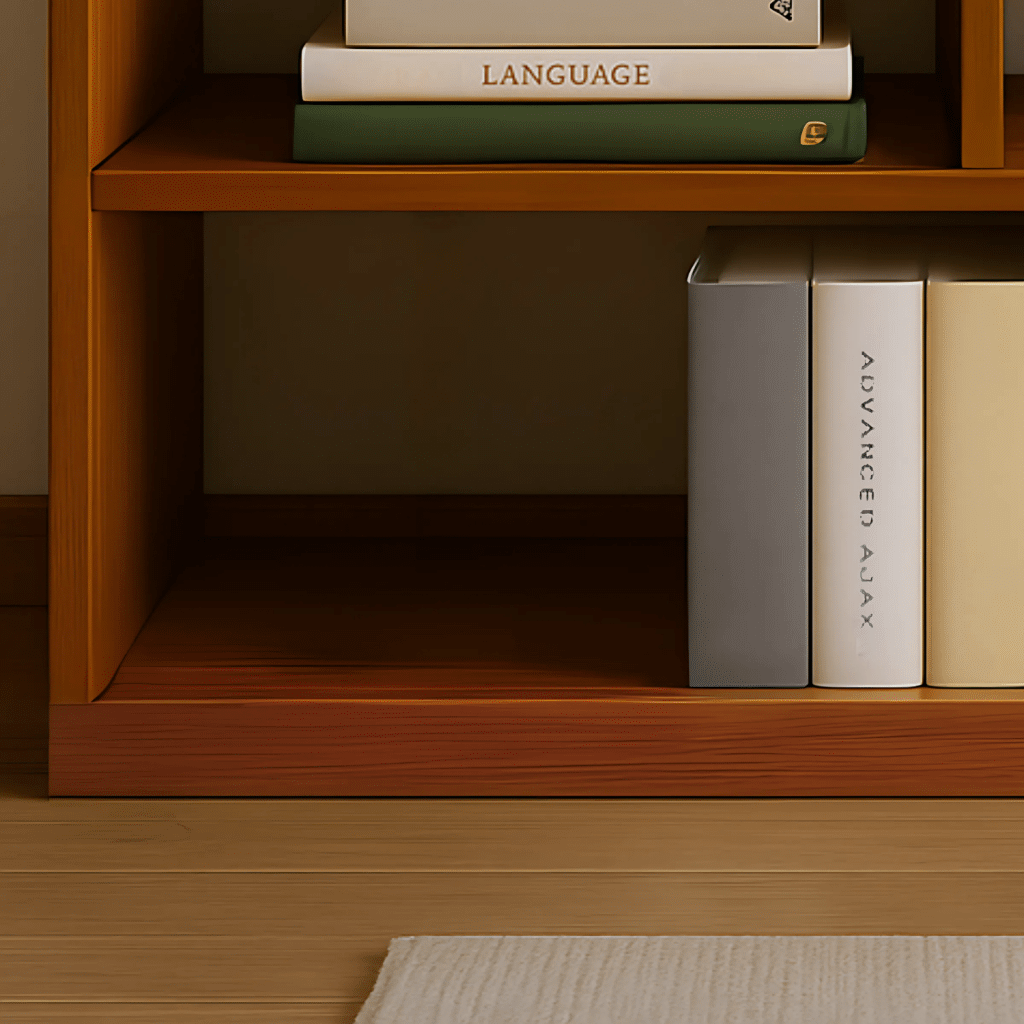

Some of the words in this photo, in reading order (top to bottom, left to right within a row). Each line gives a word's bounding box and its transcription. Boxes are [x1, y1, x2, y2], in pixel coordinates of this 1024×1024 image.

[481, 64, 651, 86] LANGUAGE
[859, 351, 876, 528] ADVANCED
[859, 544, 875, 629] AJAX
